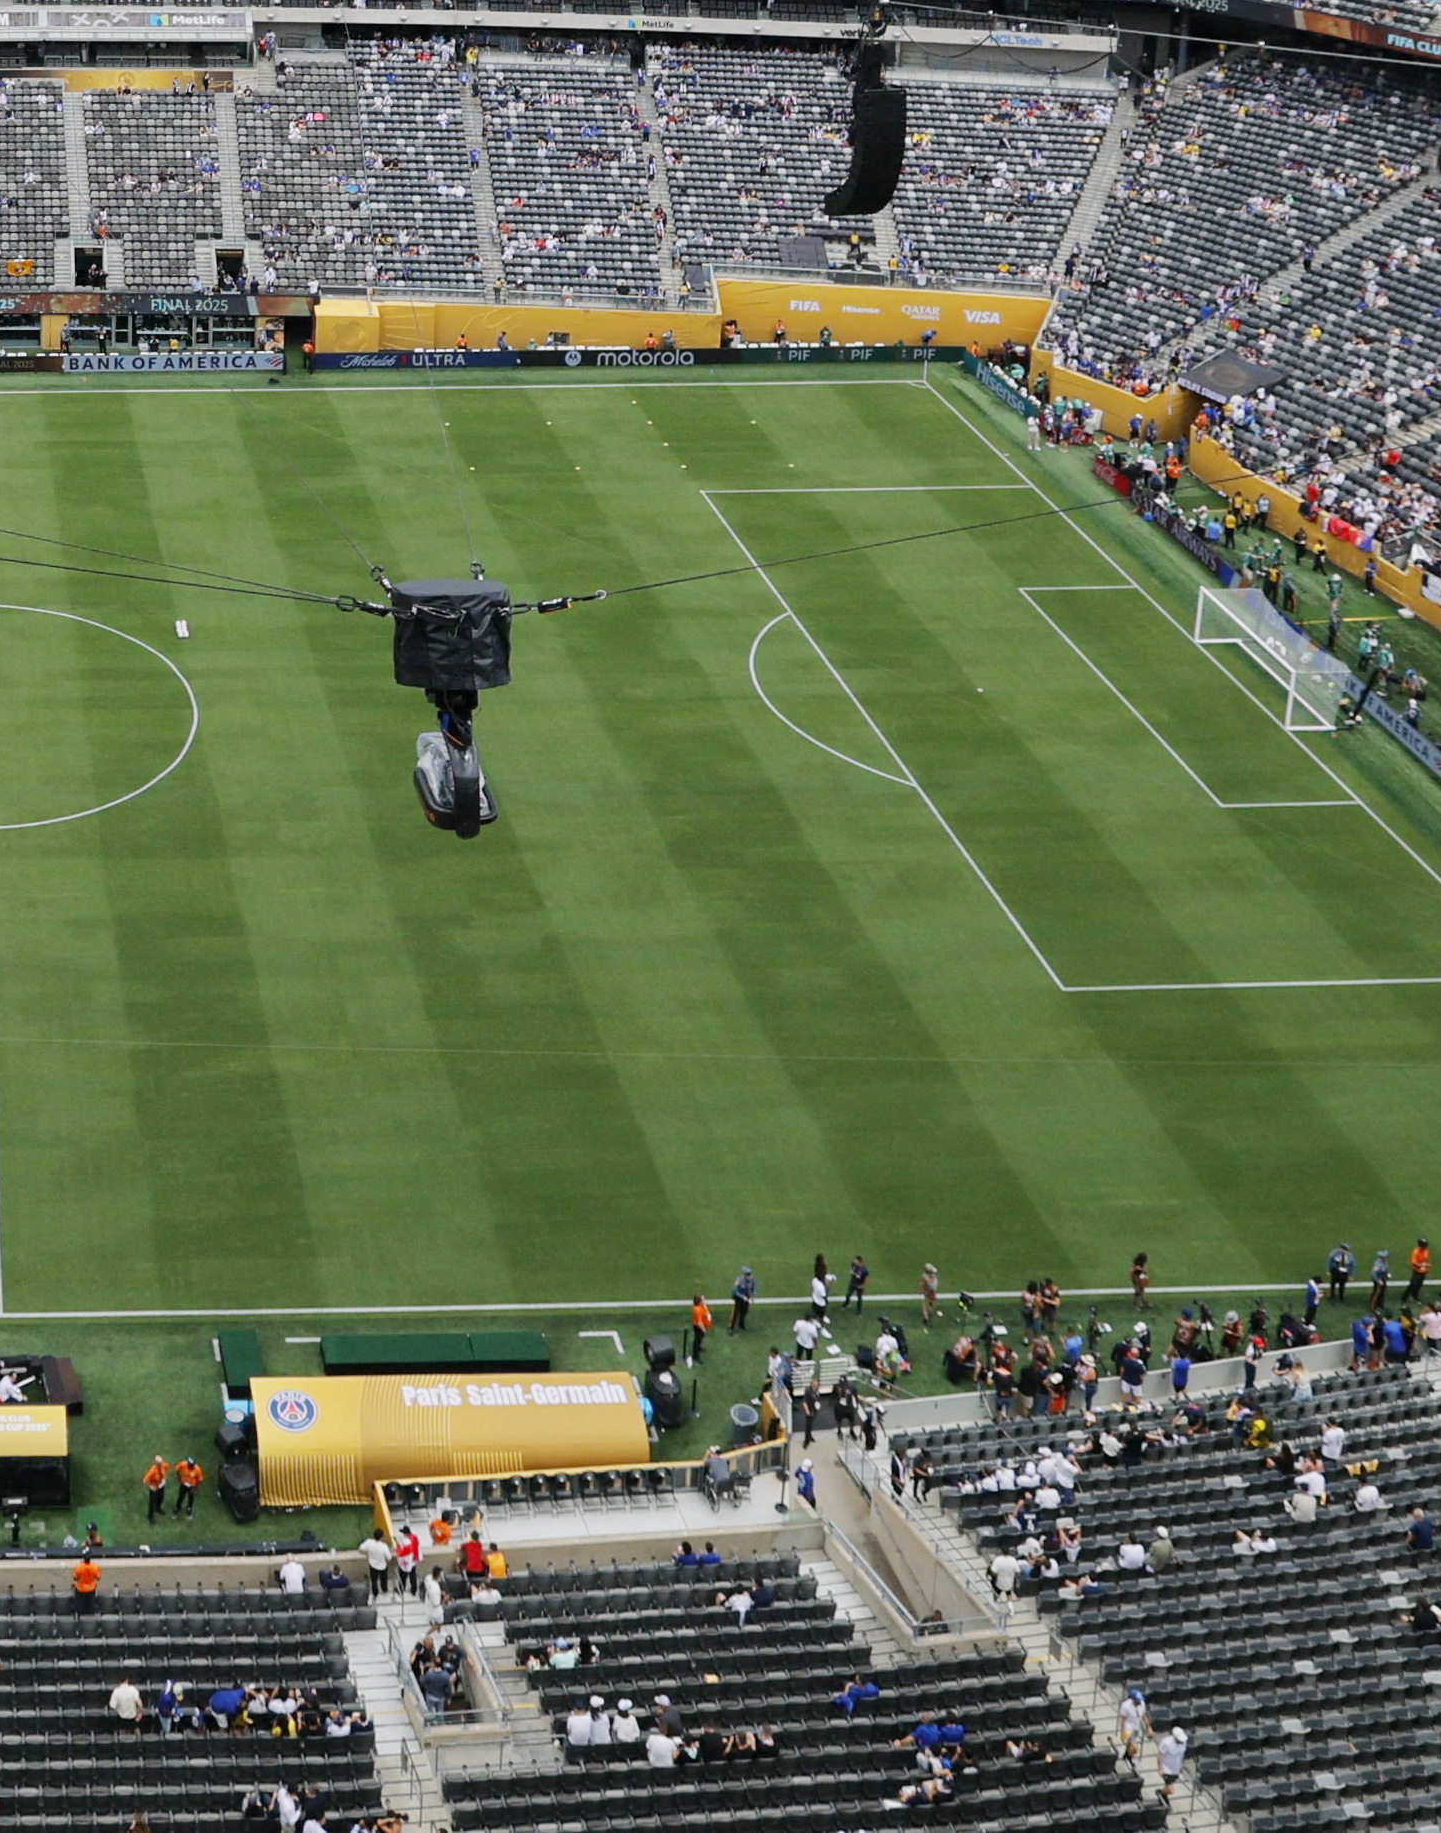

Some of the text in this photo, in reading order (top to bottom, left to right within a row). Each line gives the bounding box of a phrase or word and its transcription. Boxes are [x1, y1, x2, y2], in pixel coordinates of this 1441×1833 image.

[172, 15, 225, 25] MetLife
[642, 20, 675, 28] MetLife
[989, 34, 1042, 46] HCLTech
[1387, 34, 1415, 49] FIFA
[151, 298, 229, 312] FINAL 2025
[789, 300, 821, 312] FIFA
[842, 305, 880, 314] Hisense
[901, 304, 940, 317] QATAR
[963, 309, 1002, 324] VISA
[340, 354, 466, 368] Michelob ULTRA
[597, 349, 694, 366] motorola
[789, 349, 811, 361] PIF
[851, 348, 874, 360] PIF
[914, 348, 937, 360] PIF
[69, 356, 257, 370] BANK OF AMERICA
[976, 361, 1026, 416] Hisense
[1170, 524, 1217, 571] AIRWAYS
[1376, 705, 1431, 759] AMERICA
[400, 1380, 628, 1406] Paris Saint-Germain
